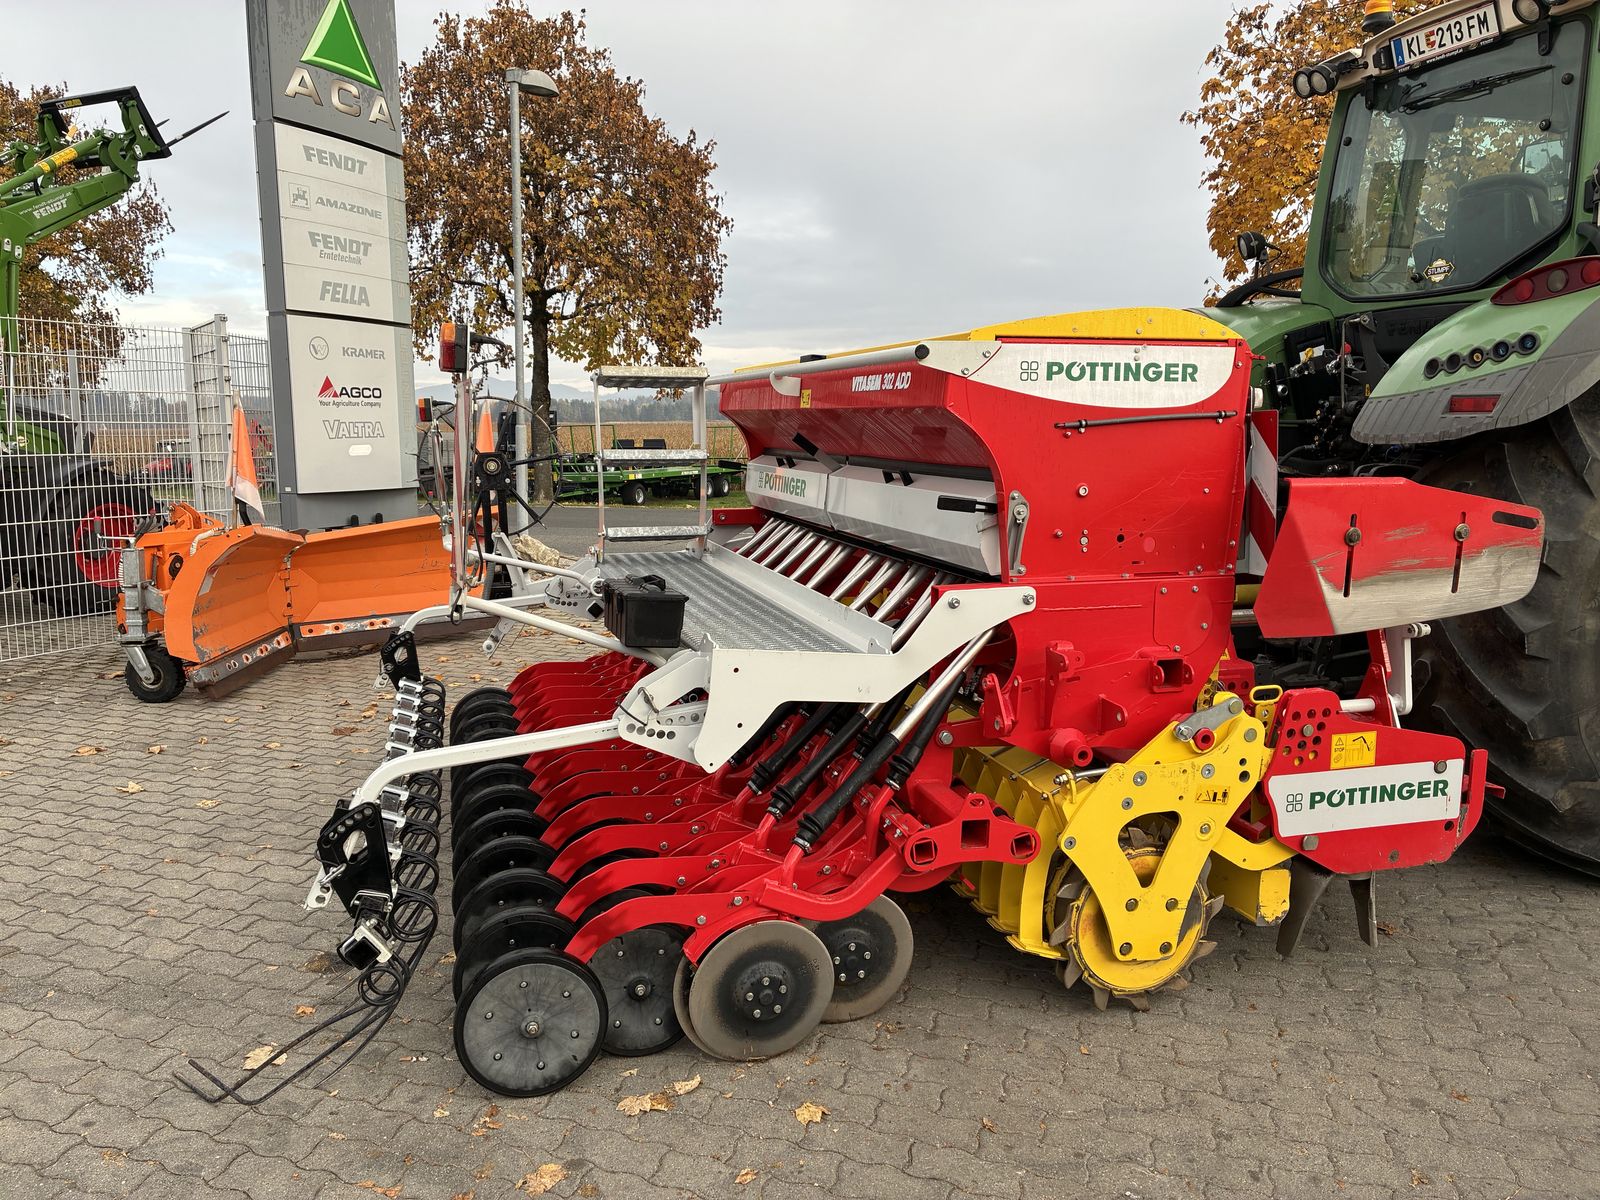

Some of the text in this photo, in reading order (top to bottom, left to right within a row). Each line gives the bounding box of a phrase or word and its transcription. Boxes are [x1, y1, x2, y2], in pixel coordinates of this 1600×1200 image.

[1406, 35, 1425, 59] KL
[1436, 21, 1464, 48] 213
[1466, 10, 1490, 38] FM
[284, 66, 396, 132] ACA
[302, 144, 368, 176] FENDT
[33, 198, 67, 219] FENDT
[315, 196, 382, 220] AMAZONE
[308, 231, 372, 257] FENDT
[319, 250, 362, 265] Erntetechnik
[319, 280, 370, 307] FELLA
[342, 346, 386, 360] KRAMER
[851, 374, 882, 392] VITASEM
[894, 372, 912, 389] ADD
[1046, 361, 1199, 382] PÖTTINGER
[339, 386, 382, 399] AGCO
[319, 399, 381, 408] Your Agriculture Company
[322, 420, 385, 439] VALTRA
[1309, 779, 1449, 810] PÖTTINGER
